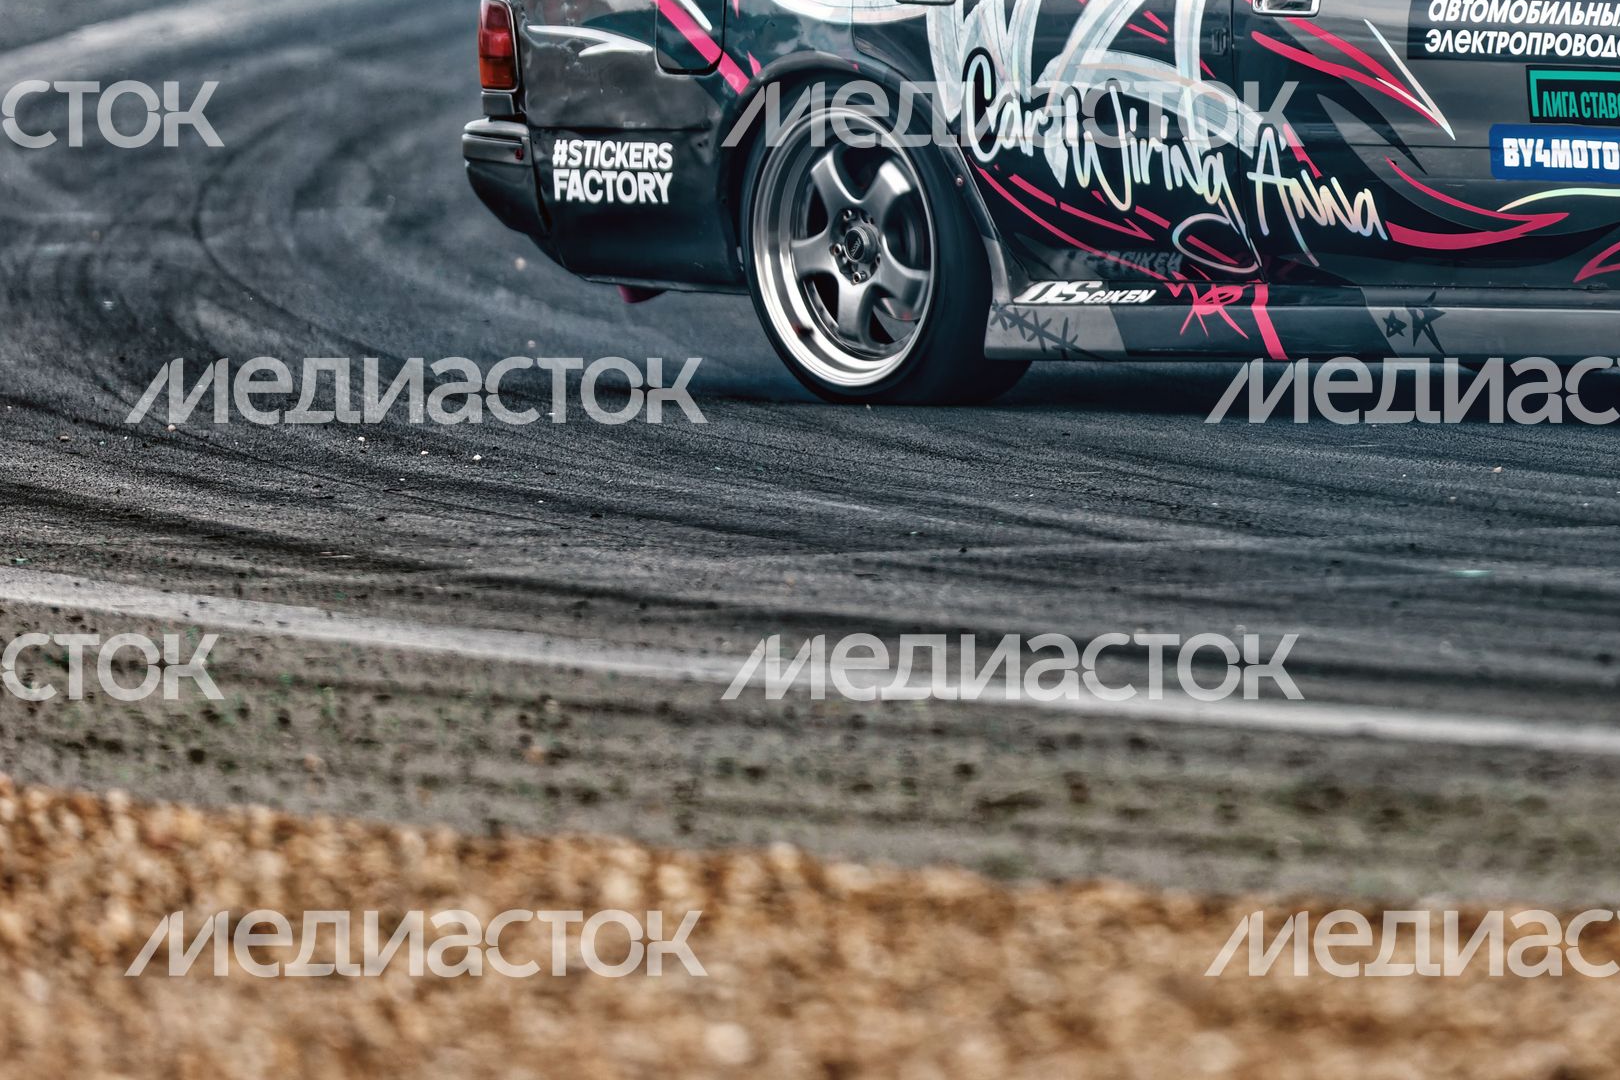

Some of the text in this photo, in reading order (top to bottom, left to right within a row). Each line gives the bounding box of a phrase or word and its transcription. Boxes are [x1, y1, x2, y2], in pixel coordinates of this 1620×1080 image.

[963, 54, 1050, 162] Car
[1542, 91, 1578, 118] ЛИГА
[552, 139, 674, 170] #STICKERS
[552, 169, 674, 204] FACTORY
[1084, 289, 1157, 304] GIKEN
